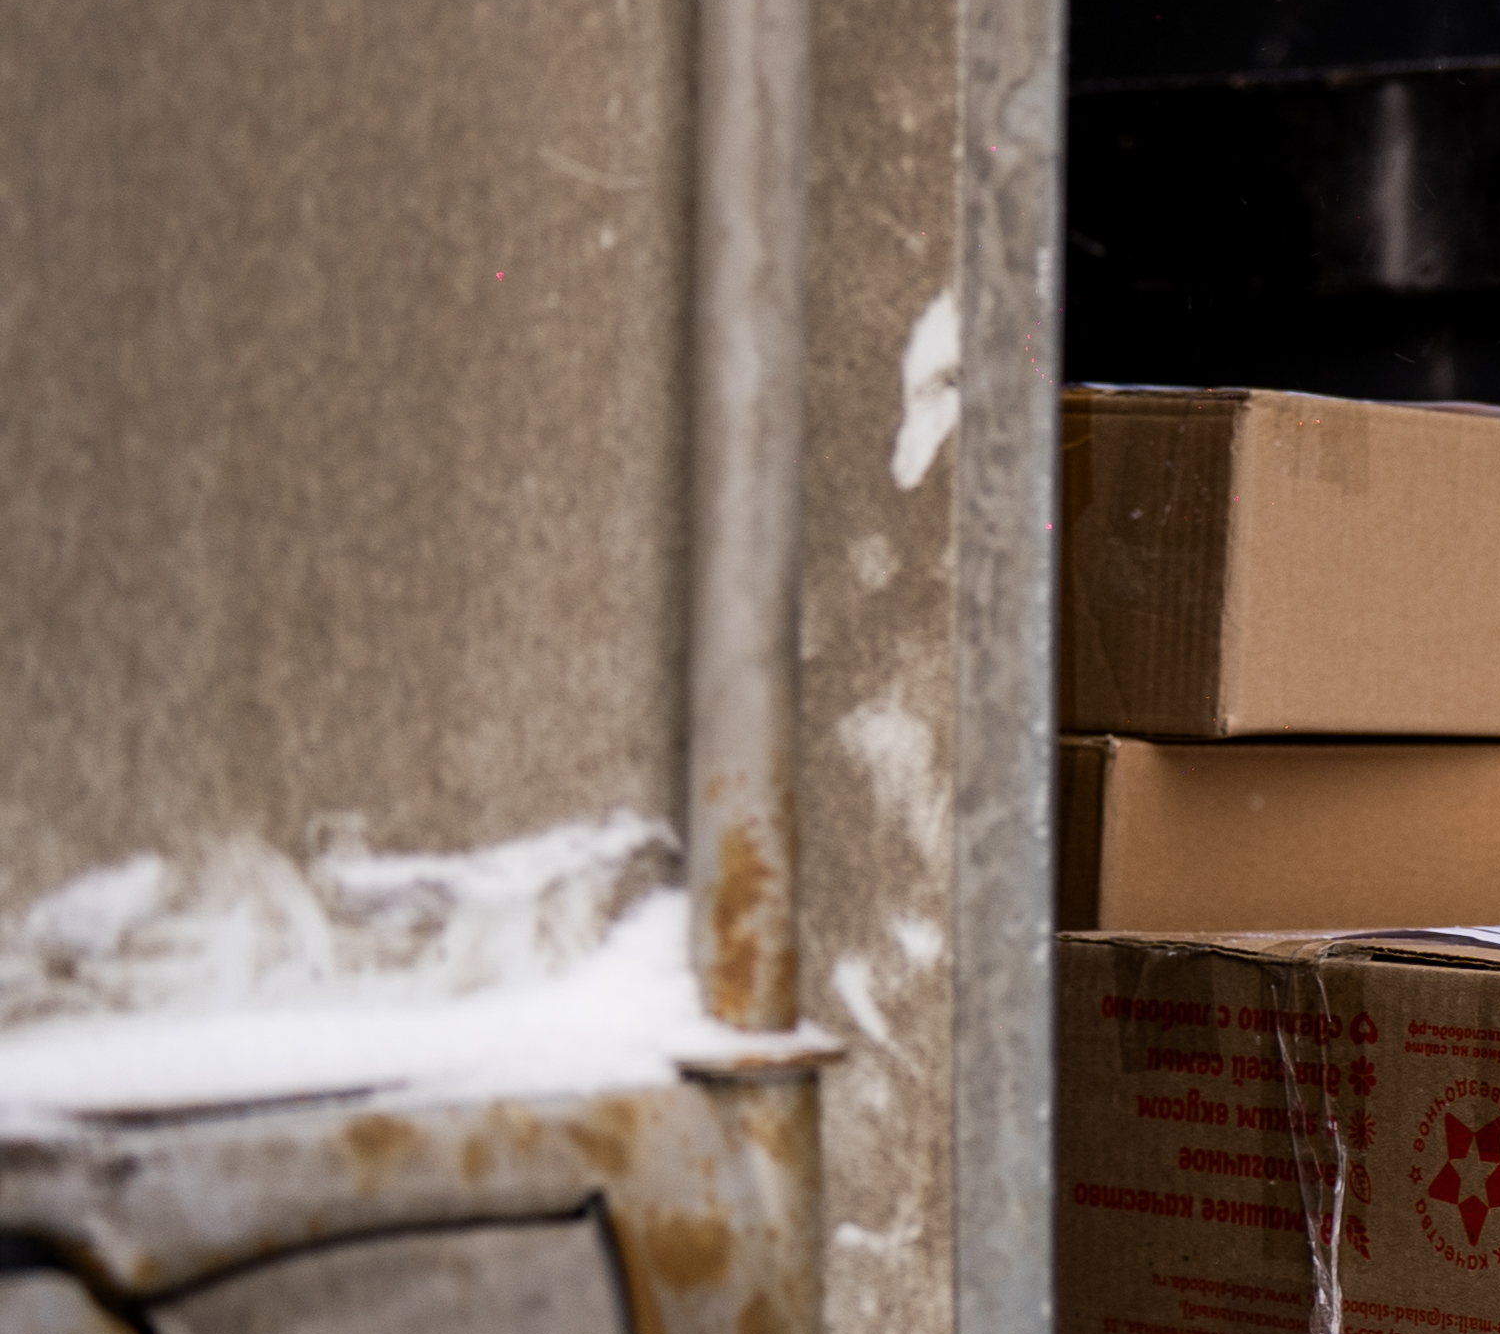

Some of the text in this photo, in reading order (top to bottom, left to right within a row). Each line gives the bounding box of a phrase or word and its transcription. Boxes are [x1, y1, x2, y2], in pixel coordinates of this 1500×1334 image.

[1100, 994, 1344, 1047] сделано с любовью
[1146, 1047, 1224, 1078] семьи
[1403, 1041, 1448, 1060] сайте
[1451, 1044, 1469, 1060] на
[1295, 1063, 1341, 1098] для
[1135, 1088, 1230, 1127] вкусом
[1072, 1181, 1334, 1246] дмашнее качество
[1414, 1197, 1489, 1270] качества
